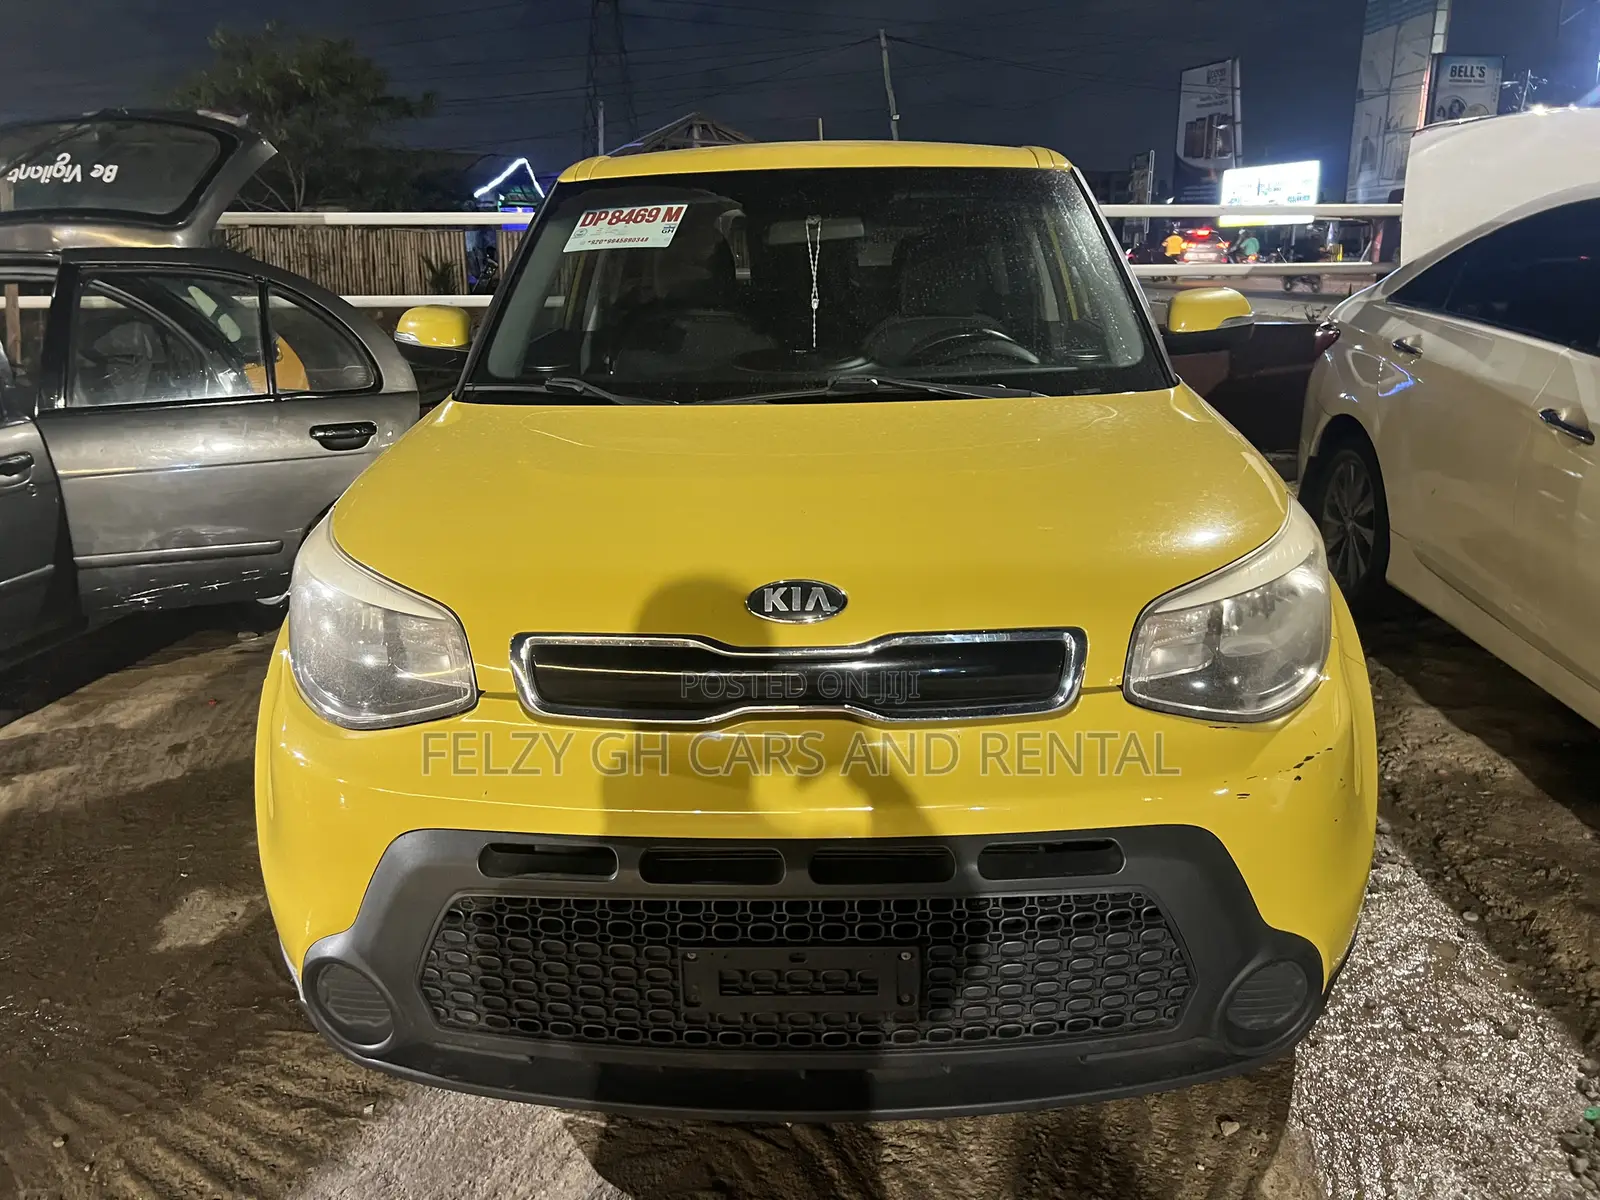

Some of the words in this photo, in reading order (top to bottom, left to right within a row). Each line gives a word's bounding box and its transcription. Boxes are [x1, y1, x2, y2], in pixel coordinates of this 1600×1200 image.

[1450, 65, 1486, 78] BELL'S
[6, 152, 82, 184] Vigilant
[90, 164, 119, 183] Be
[579, 211, 609, 227] DP
[607, 207, 662, 226] 8469
[661, 206, 684, 223] M
[764, 587, 831, 612] KIA
